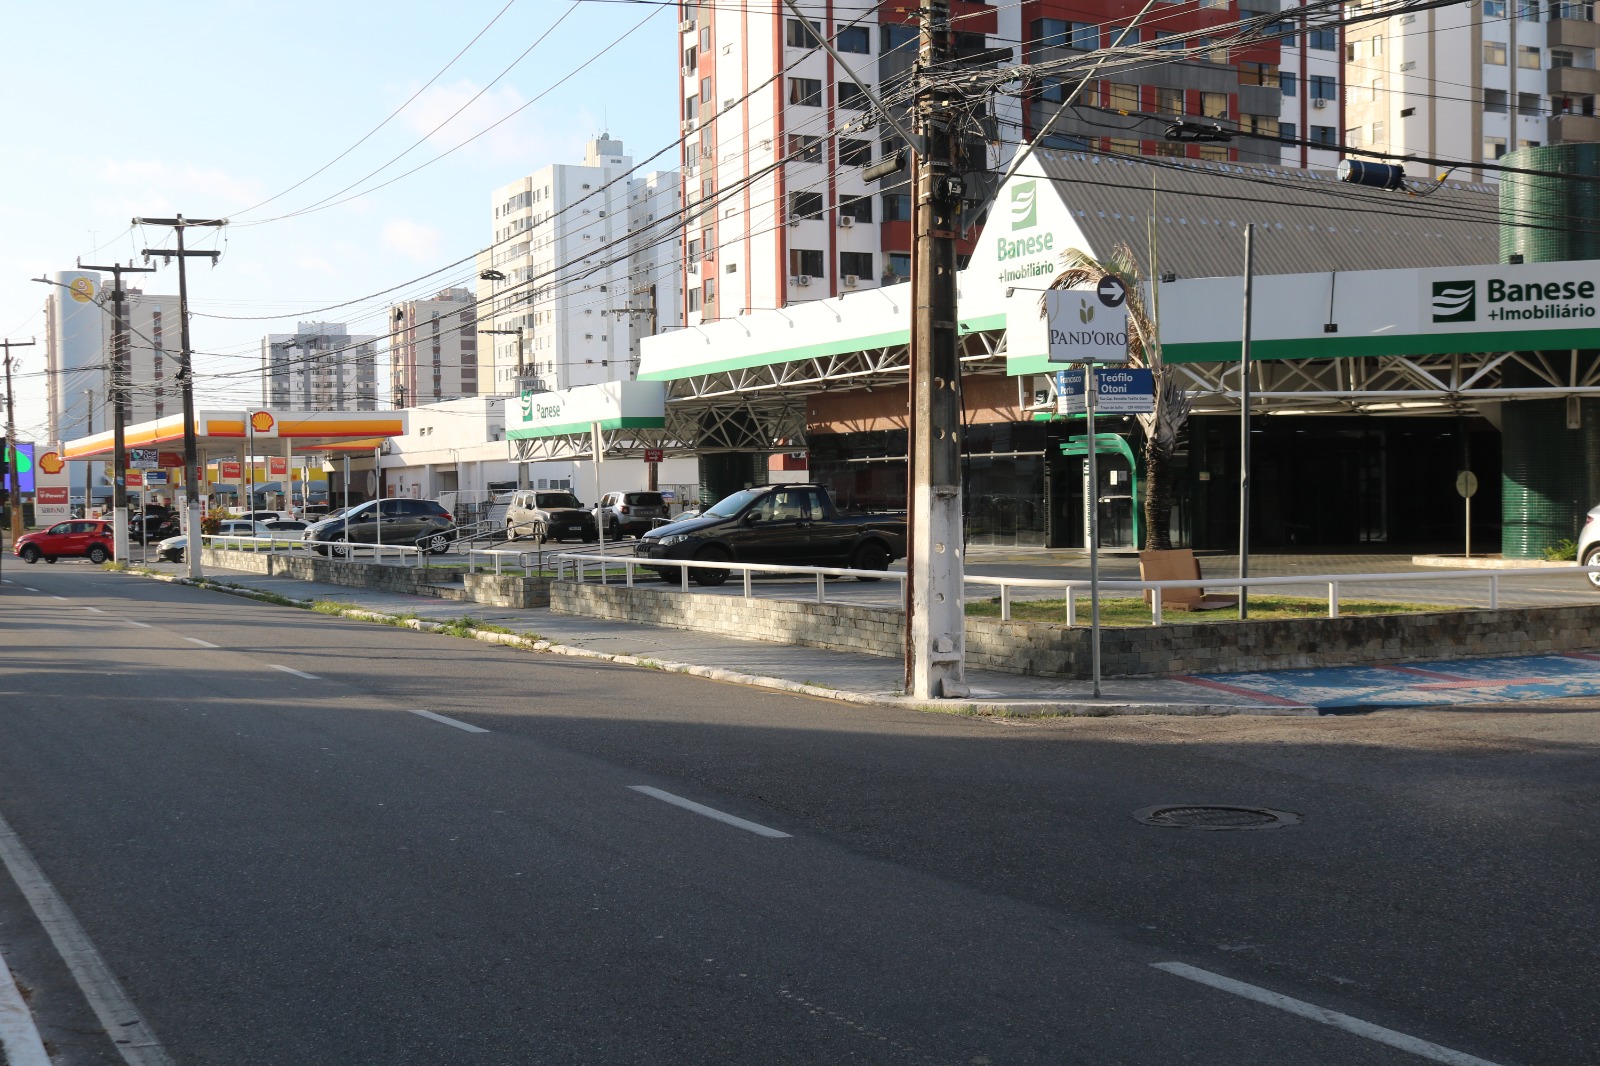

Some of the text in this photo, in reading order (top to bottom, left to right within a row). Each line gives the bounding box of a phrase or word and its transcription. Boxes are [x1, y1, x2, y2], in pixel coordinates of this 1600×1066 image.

[997, 231, 1053, 262] Banese
[998, 261, 1054, 284] +Imobiliário
[1488, 278, 1595, 303] Banese
[1487, 304, 1596, 322] +Imobiliário
[1050, 329, 1127, 346] PAND'ORO
[1060, 374, 1082, 384] Francisco
[1101, 373, 1133, 382] Teófilo
[1060, 386, 1074, 395] Porto
[1101, 384, 1127, 393] Otoni
[536, 403, 561, 419] Banese
